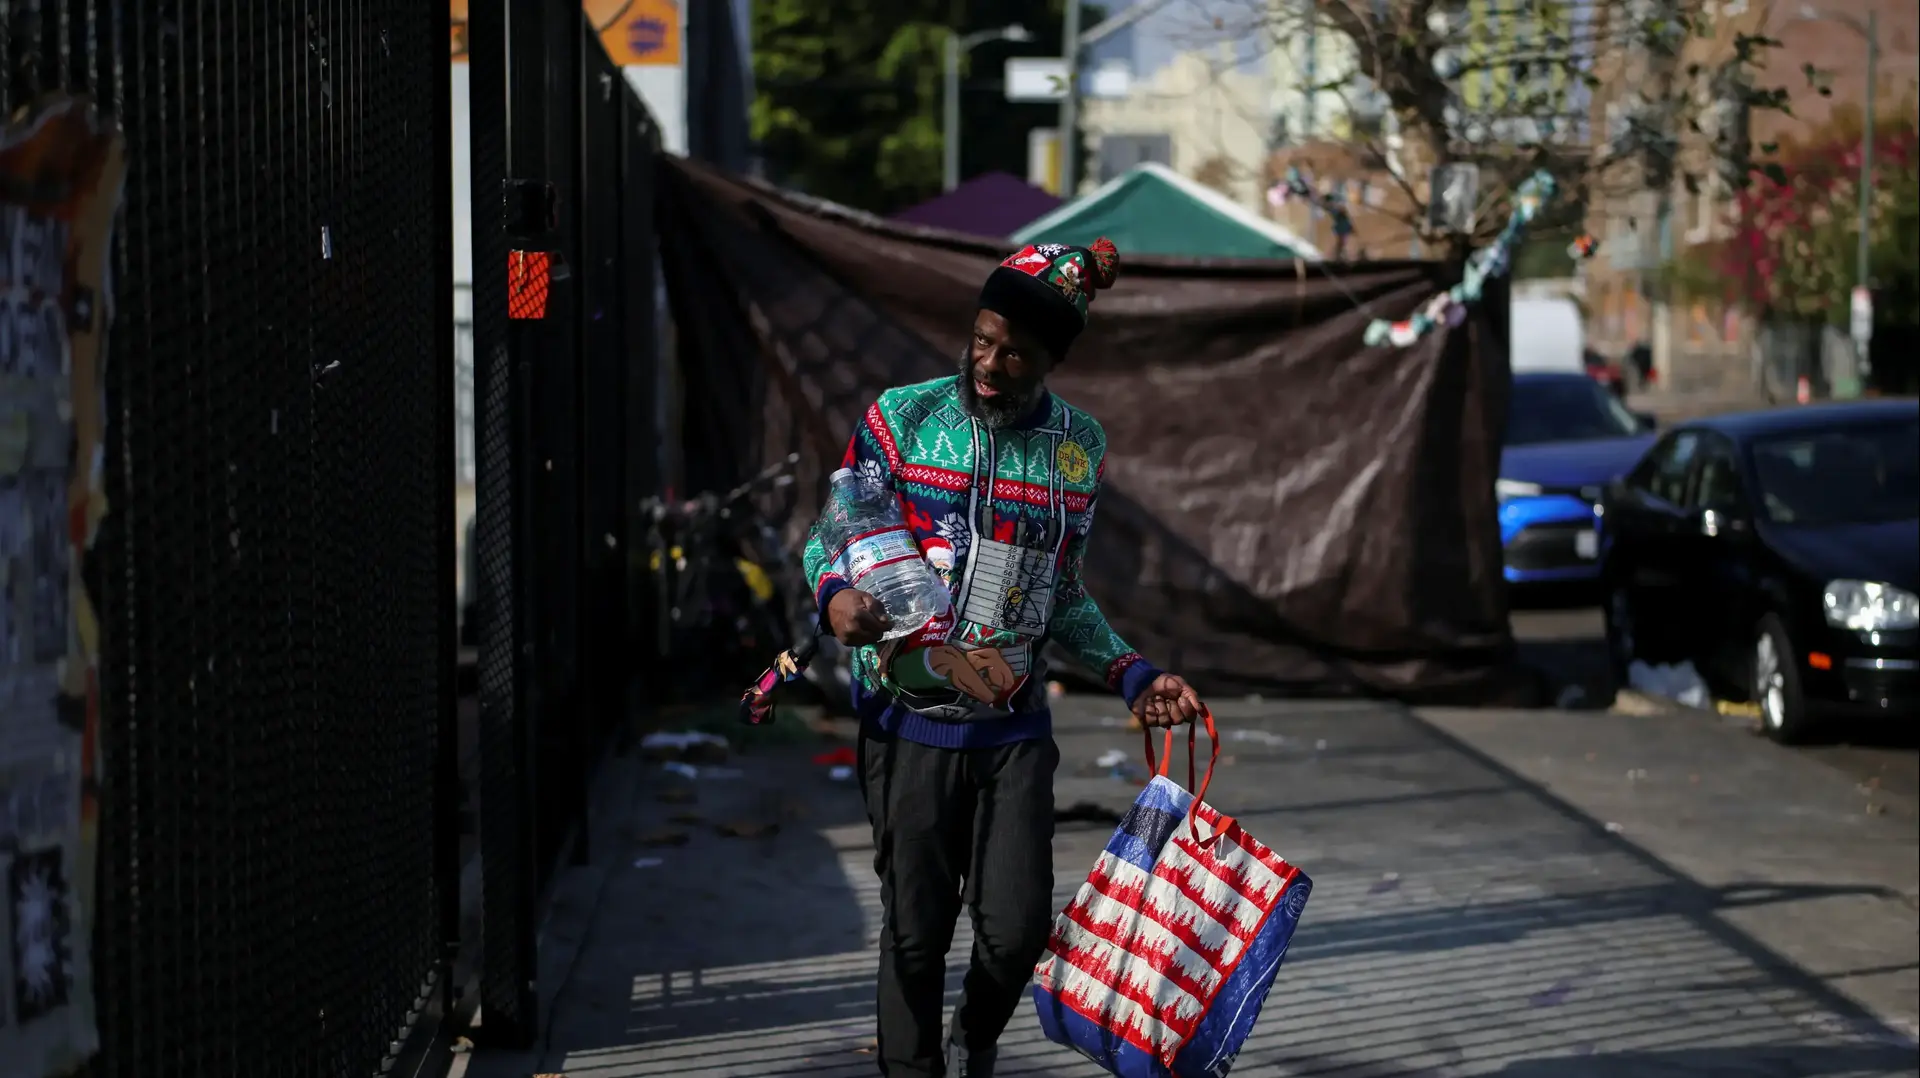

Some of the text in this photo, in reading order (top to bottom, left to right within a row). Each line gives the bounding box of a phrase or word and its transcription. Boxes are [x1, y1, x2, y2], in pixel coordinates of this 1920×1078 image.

[1001, 578, 1011, 586] 50
[990, 620, 1000, 628] 50
[920, 631, 947, 642] SWOLE
